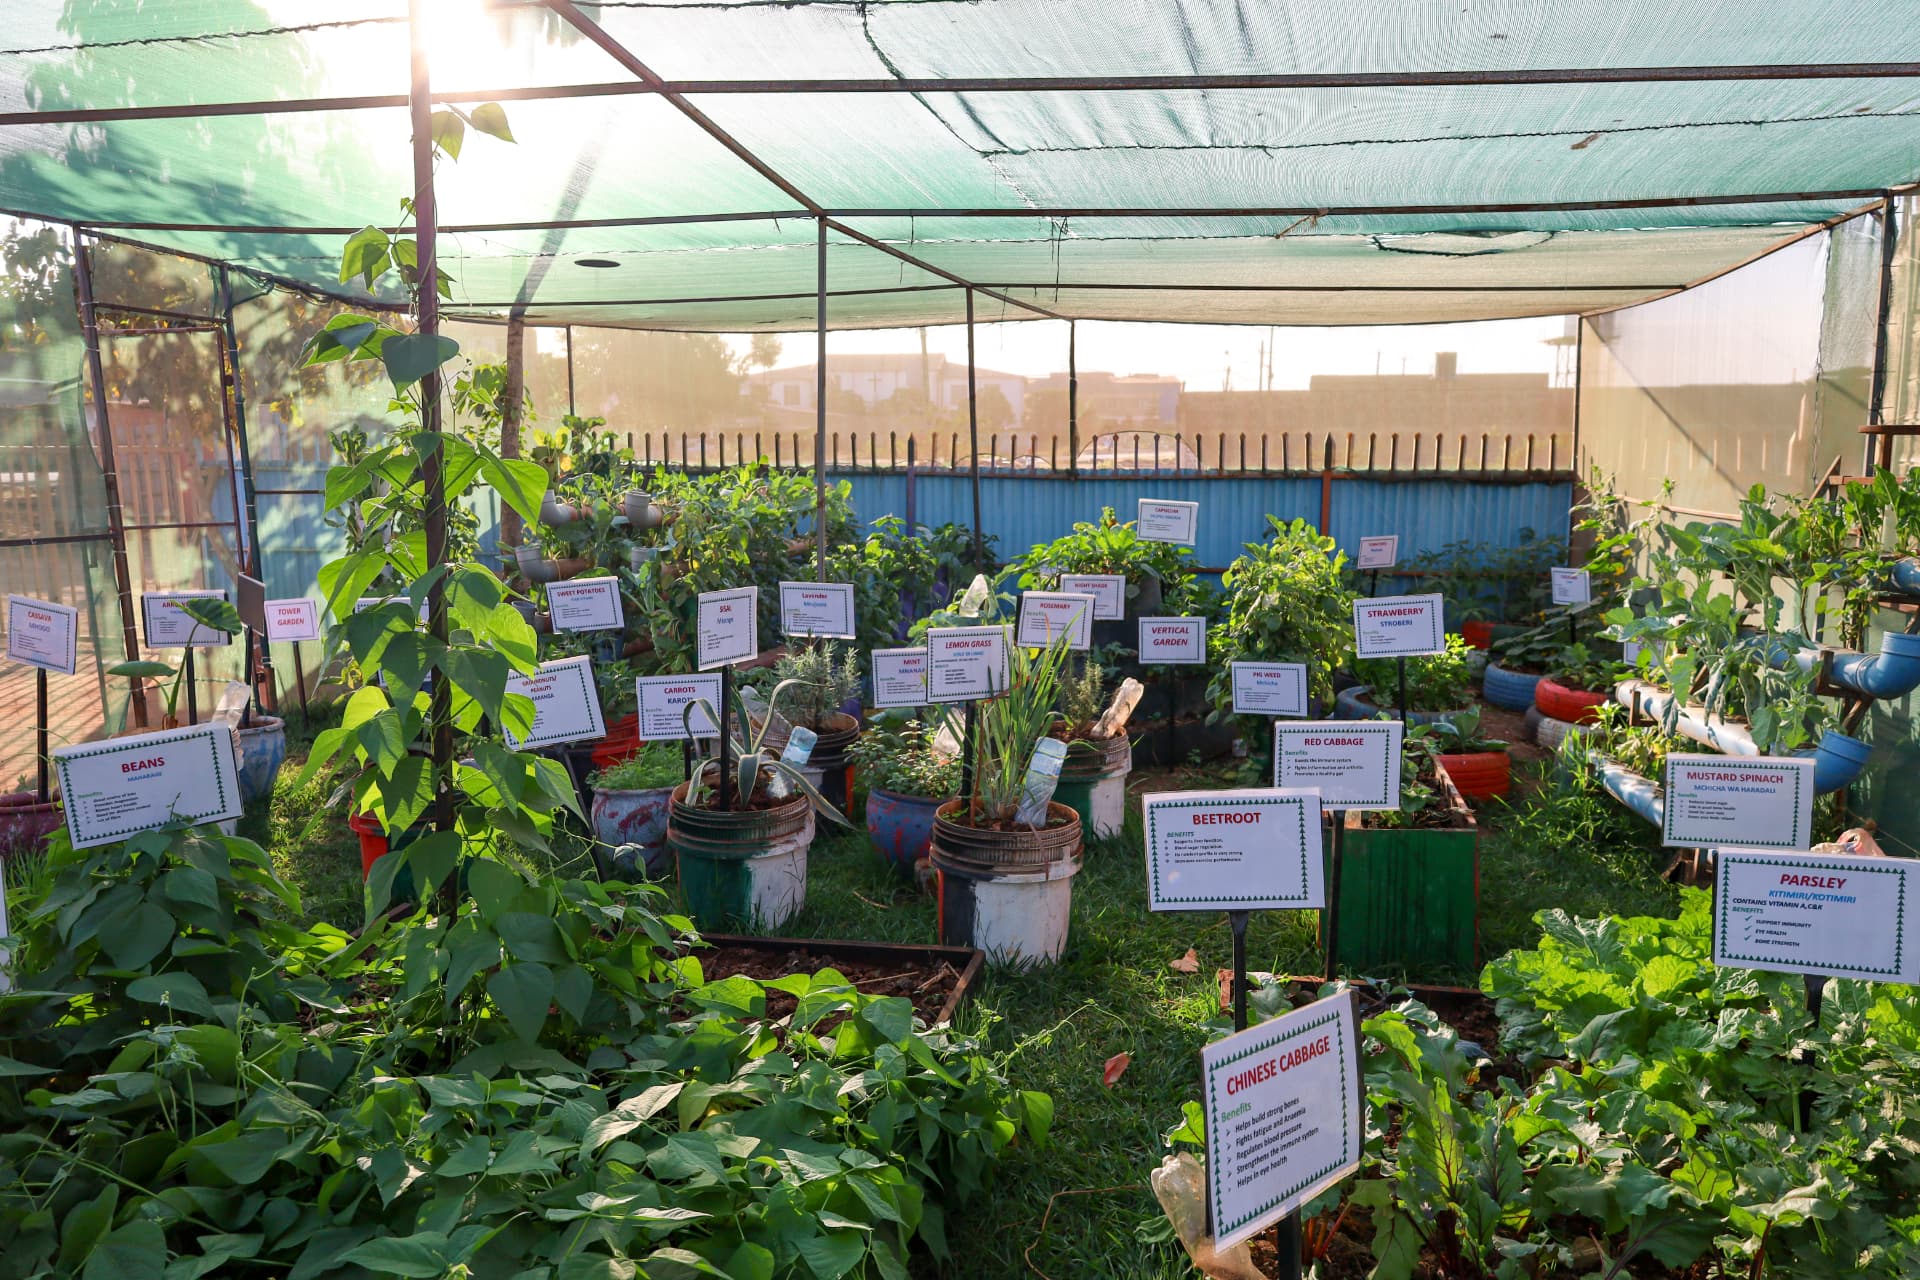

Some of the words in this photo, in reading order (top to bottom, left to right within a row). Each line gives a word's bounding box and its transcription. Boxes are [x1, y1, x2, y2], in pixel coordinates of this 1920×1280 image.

[1367, 608, 1424, 618] STRAWBERRY
[945, 641, 970, 649] LEMON
[970, 640, 992, 648] GRASS
[1304, 738, 1321, 746] RED
[1323, 738, 1364, 746] CABBAGE
[121, 757, 165, 773] BEANS
[1687, 772, 1737, 782] MUSTARD
[1739, 774, 1784, 784] SPINACH
[1192, 812, 1262, 825] BEETROOT
[1780, 873, 1847, 889] PARSLEY
[1732, 898, 1767, 906] CONTAINS
[1768, 900, 1799, 908] VITAMIN
[1732, 906, 1764, 914] BENEFITS
[1227, 1059, 1277, 1096] CHINESE
[1279, 1035, 1330, 1072] CABBAGE
[1221, 1102, 1252, 1123] Benefits
[1235, 1121, 1251, 1133] Helps
[1252, 1111, 1266, 1125] build
[1266, 1105, 1283, 1119] strong
[1283, 1097, 1300, 1110] bones
[1235, 1133, 1252, 1147] Fights
[1253, 1124, 1272, 1137] fatigue
[1273, 1118, 1283, 1128] and
[1284, 1107, 1306, 1122] Anaemia
[1236, 1144, 1263, 1160] Regulates
[1264, 1134, 1279, 1147] blood
[1280, 1122, 1302, 1140] pressure
[1236, 1152, 1269, 1174] Strengthens
[1270, 1147, 1279, 1156] the
[1280, 1136, 1301, 1151] immune
[1301, 1127, 1319, 1141] system
[1237, 1175, 1253, 1188] Helps
[1260, 1166, 1270, 1176] eye
[1270, 1156, 1288, 1169] health
